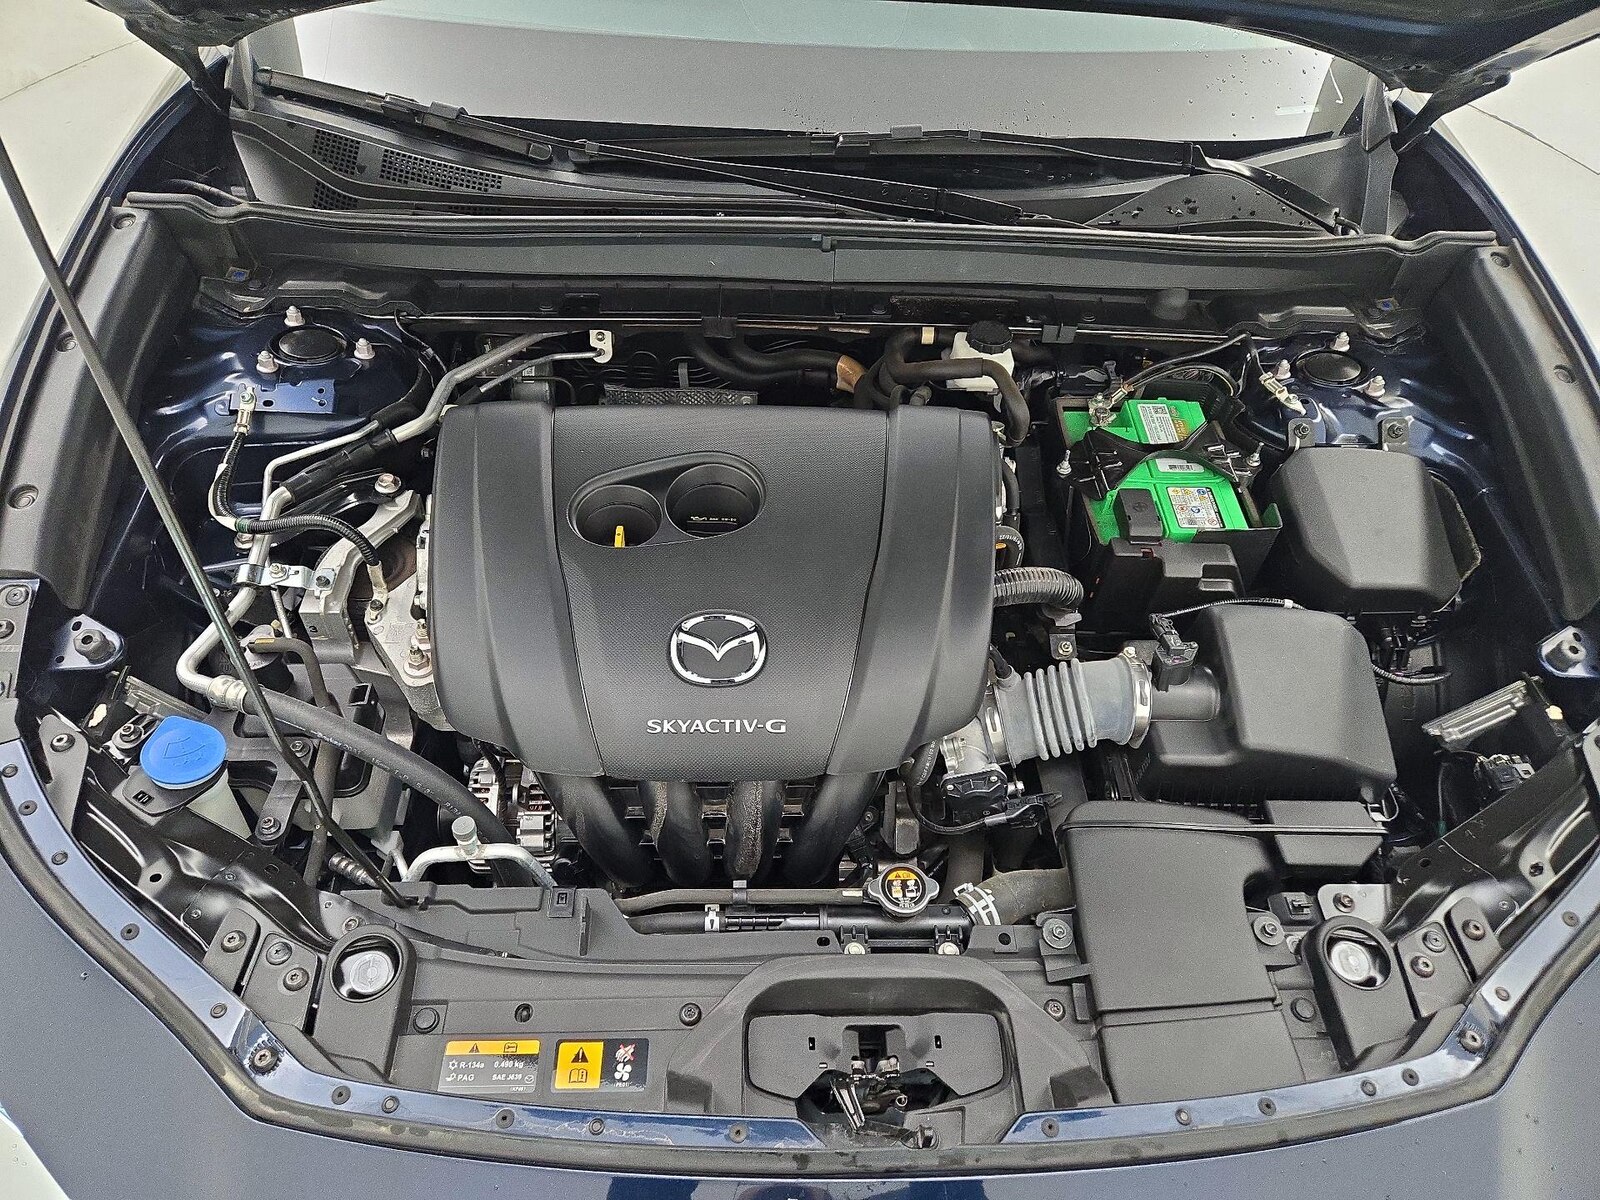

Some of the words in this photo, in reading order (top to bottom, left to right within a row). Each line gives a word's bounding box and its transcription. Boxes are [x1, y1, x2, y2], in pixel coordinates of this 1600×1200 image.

[646, 719, 787, 734] SKYACTIV-G
[459, 1061, 485, 1069] R-134a
[514, 1060, 524, 1069] kg
